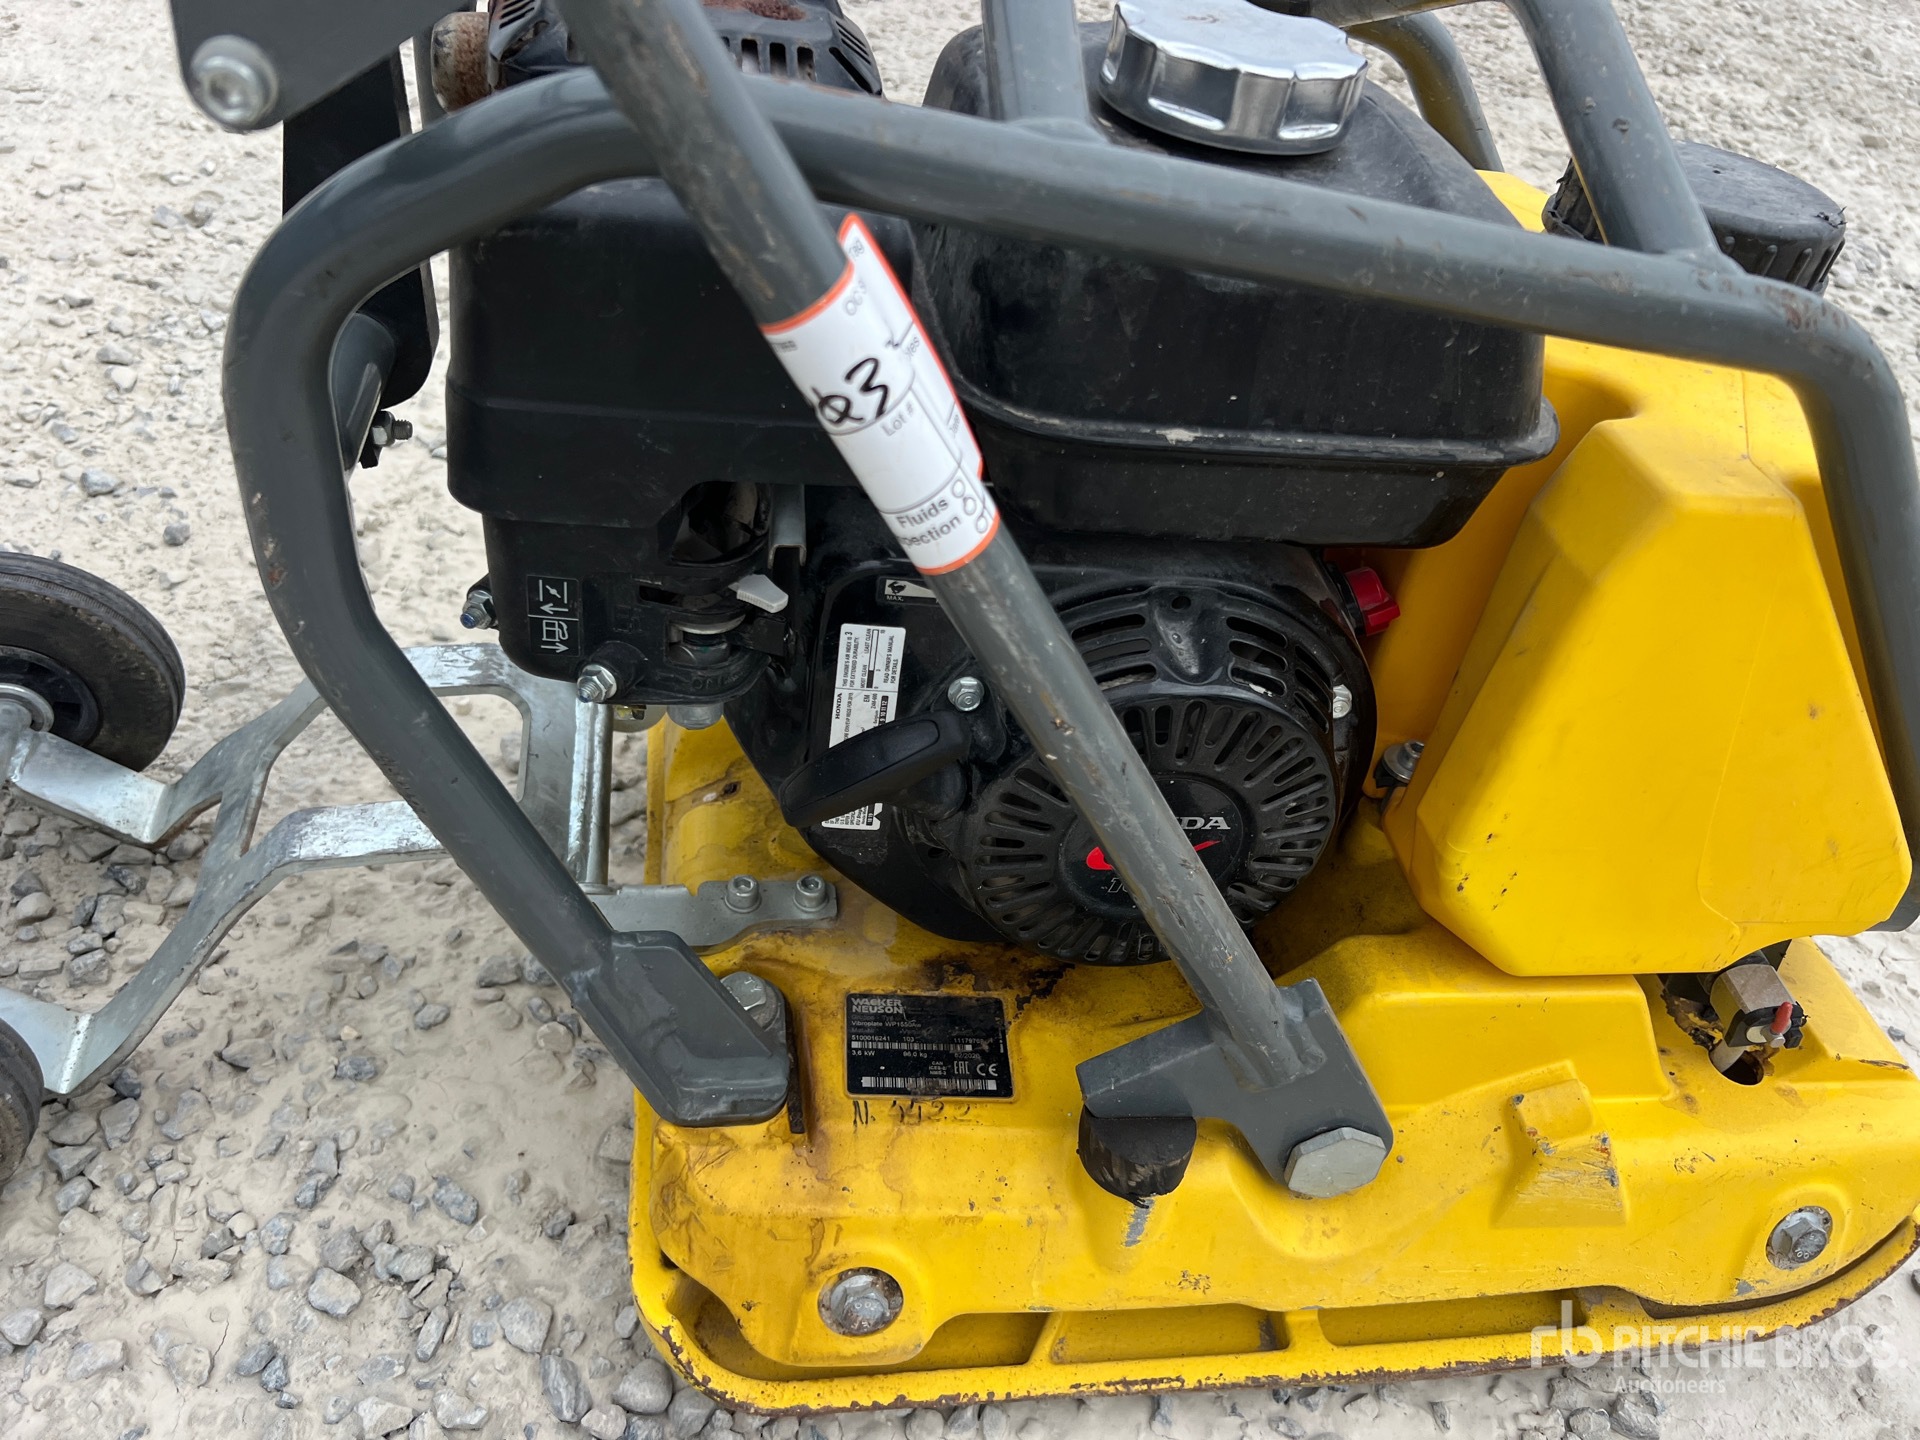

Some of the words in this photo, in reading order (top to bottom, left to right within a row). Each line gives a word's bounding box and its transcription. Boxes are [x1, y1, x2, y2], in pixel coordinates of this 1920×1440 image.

[881, 413, 907, 437] Lot
[897, 498, 948, 529] Fluids
[863, 694, 870, 702] EM
[1178, 816, 1231, 830] DA
[851, 998, 902, 1007] WACKER
[852, 1006, 904, 1014] NEUSON
